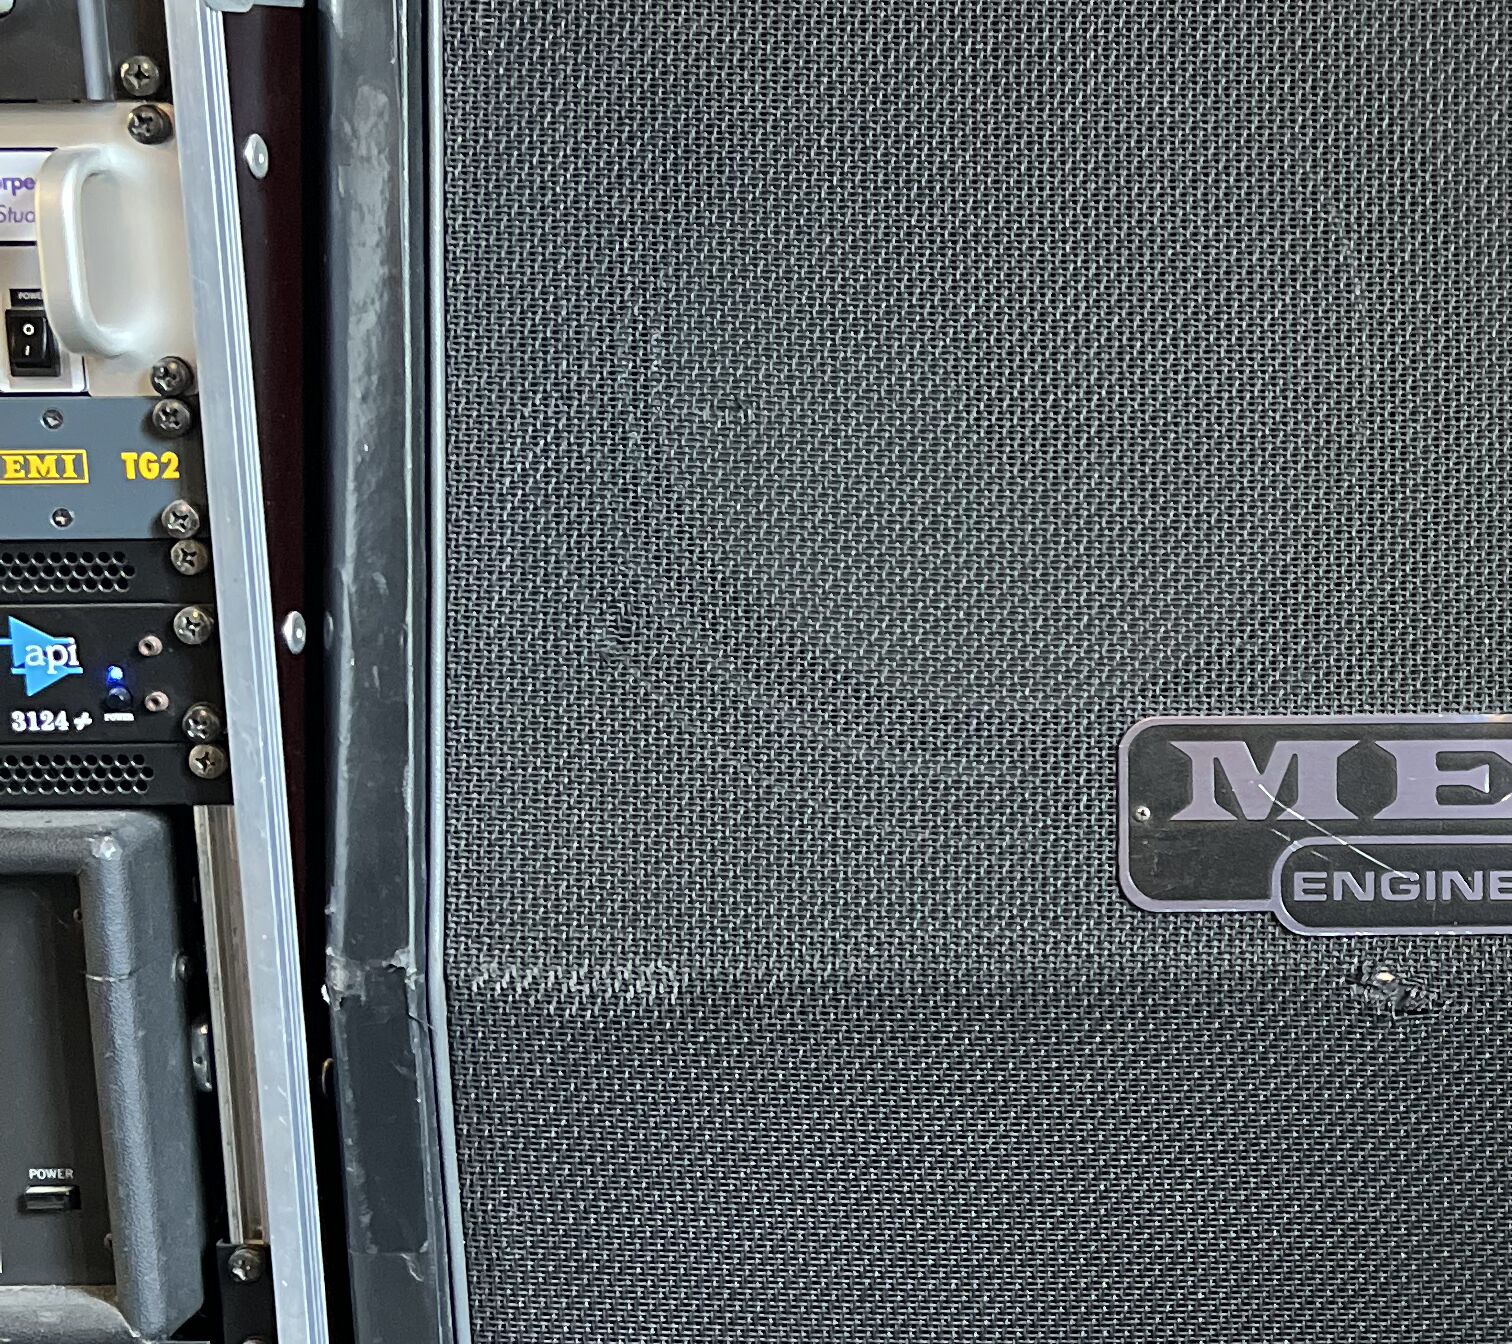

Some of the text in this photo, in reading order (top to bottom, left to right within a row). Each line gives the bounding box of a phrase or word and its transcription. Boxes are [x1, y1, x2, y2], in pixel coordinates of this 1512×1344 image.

[0, 177, 36, 197] rpe
[3, 451, 180, 480] EMI TG2
[25, 637, 80, 675] api
[28, 1167, 74, 1180] POWER
